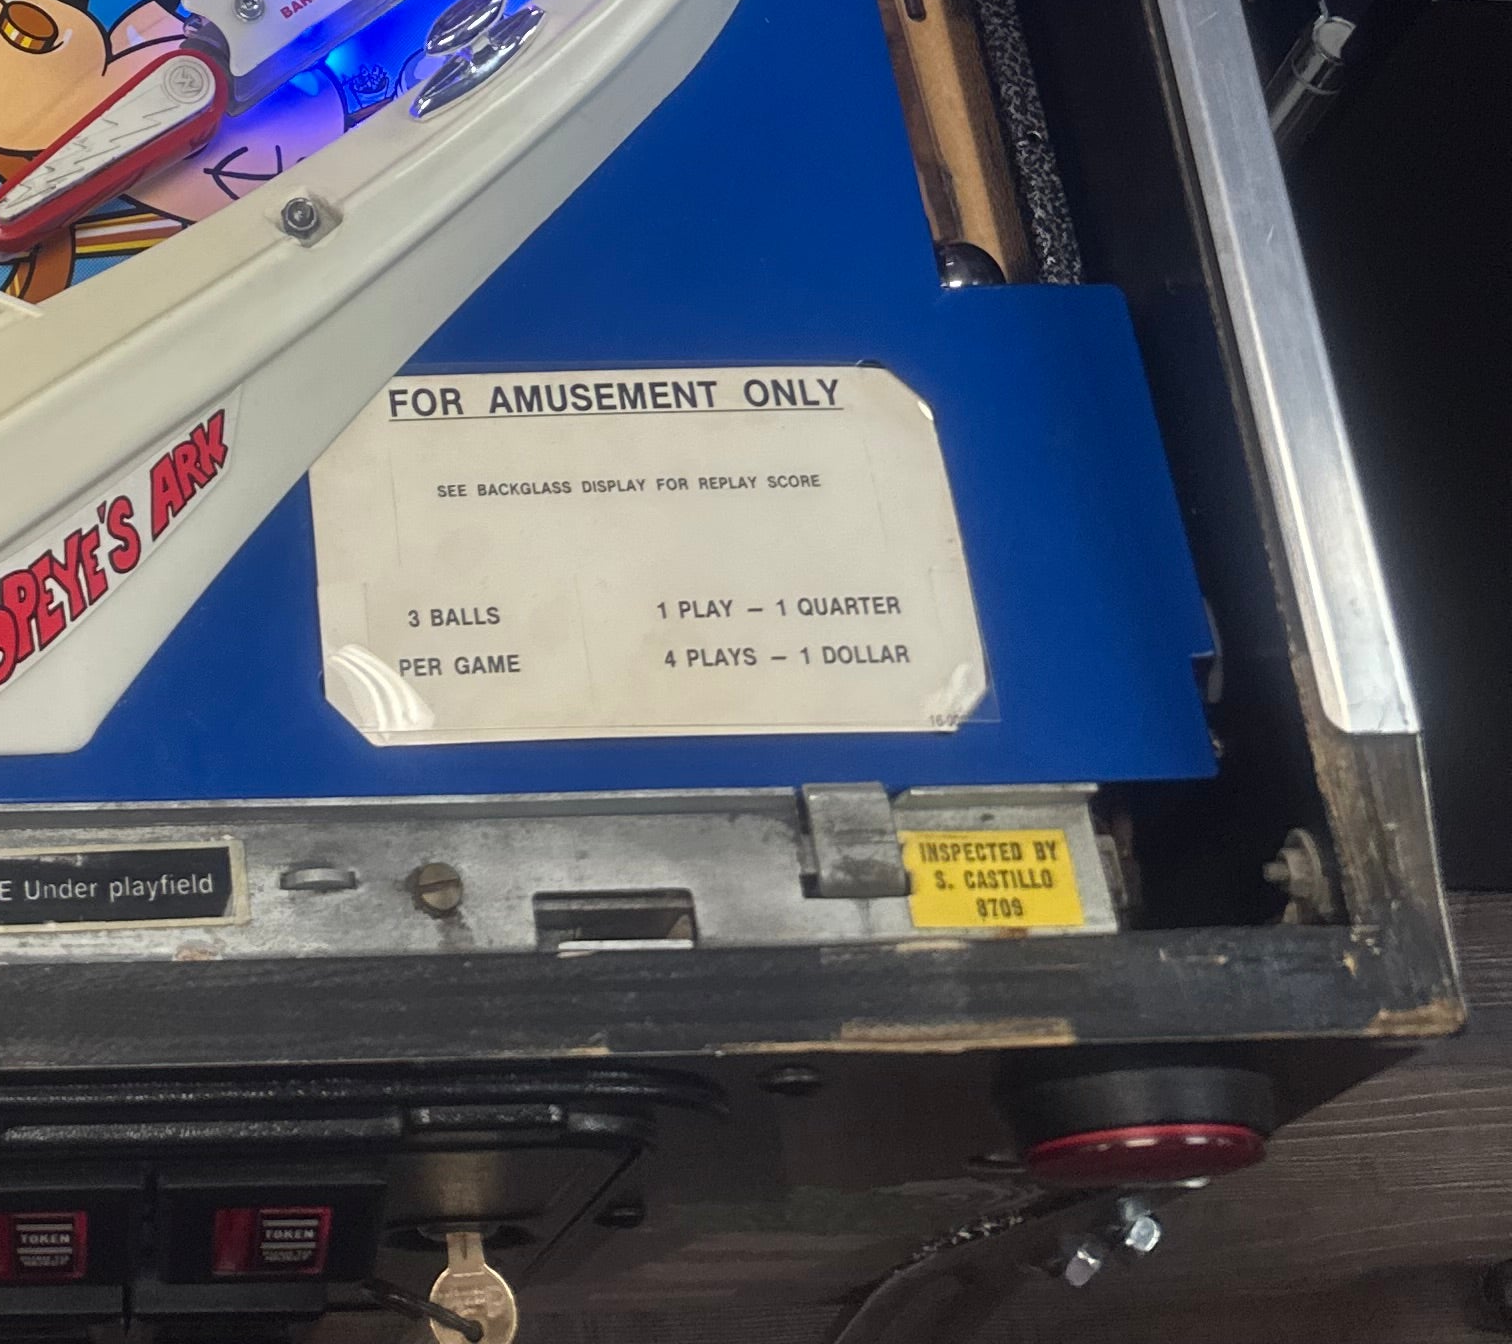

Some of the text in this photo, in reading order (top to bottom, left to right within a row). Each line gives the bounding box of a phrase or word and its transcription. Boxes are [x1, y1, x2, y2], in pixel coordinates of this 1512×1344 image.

[389, 377, 840, 418] FOR AMUSEMENT ONLY
[149, 408, 228, 542] ARK
[437, 474, 821, 498] SEE BACKGLASS DISPLAY FOR REPLAY SCORE
[408, 606, 501, 628] 3 BALLS
[656, 596, 902, 619] 1 PLAY 1 QUARTER
[399, 654, 521, 677] PER GAME
[664, 644, 911, 668] 4 PLAYS 1 DOLLAR
[919, 840, 1057, 863] INSPECTED BY
[24, 878, 97, 901] Under
[109, 873, 214, 904] playfield
[934, 869, 1054, 889] S. CASTILLO
[20, 1233, 70, 1244] TOKEN
[264, 1229, 315, 1239] TOKEN
